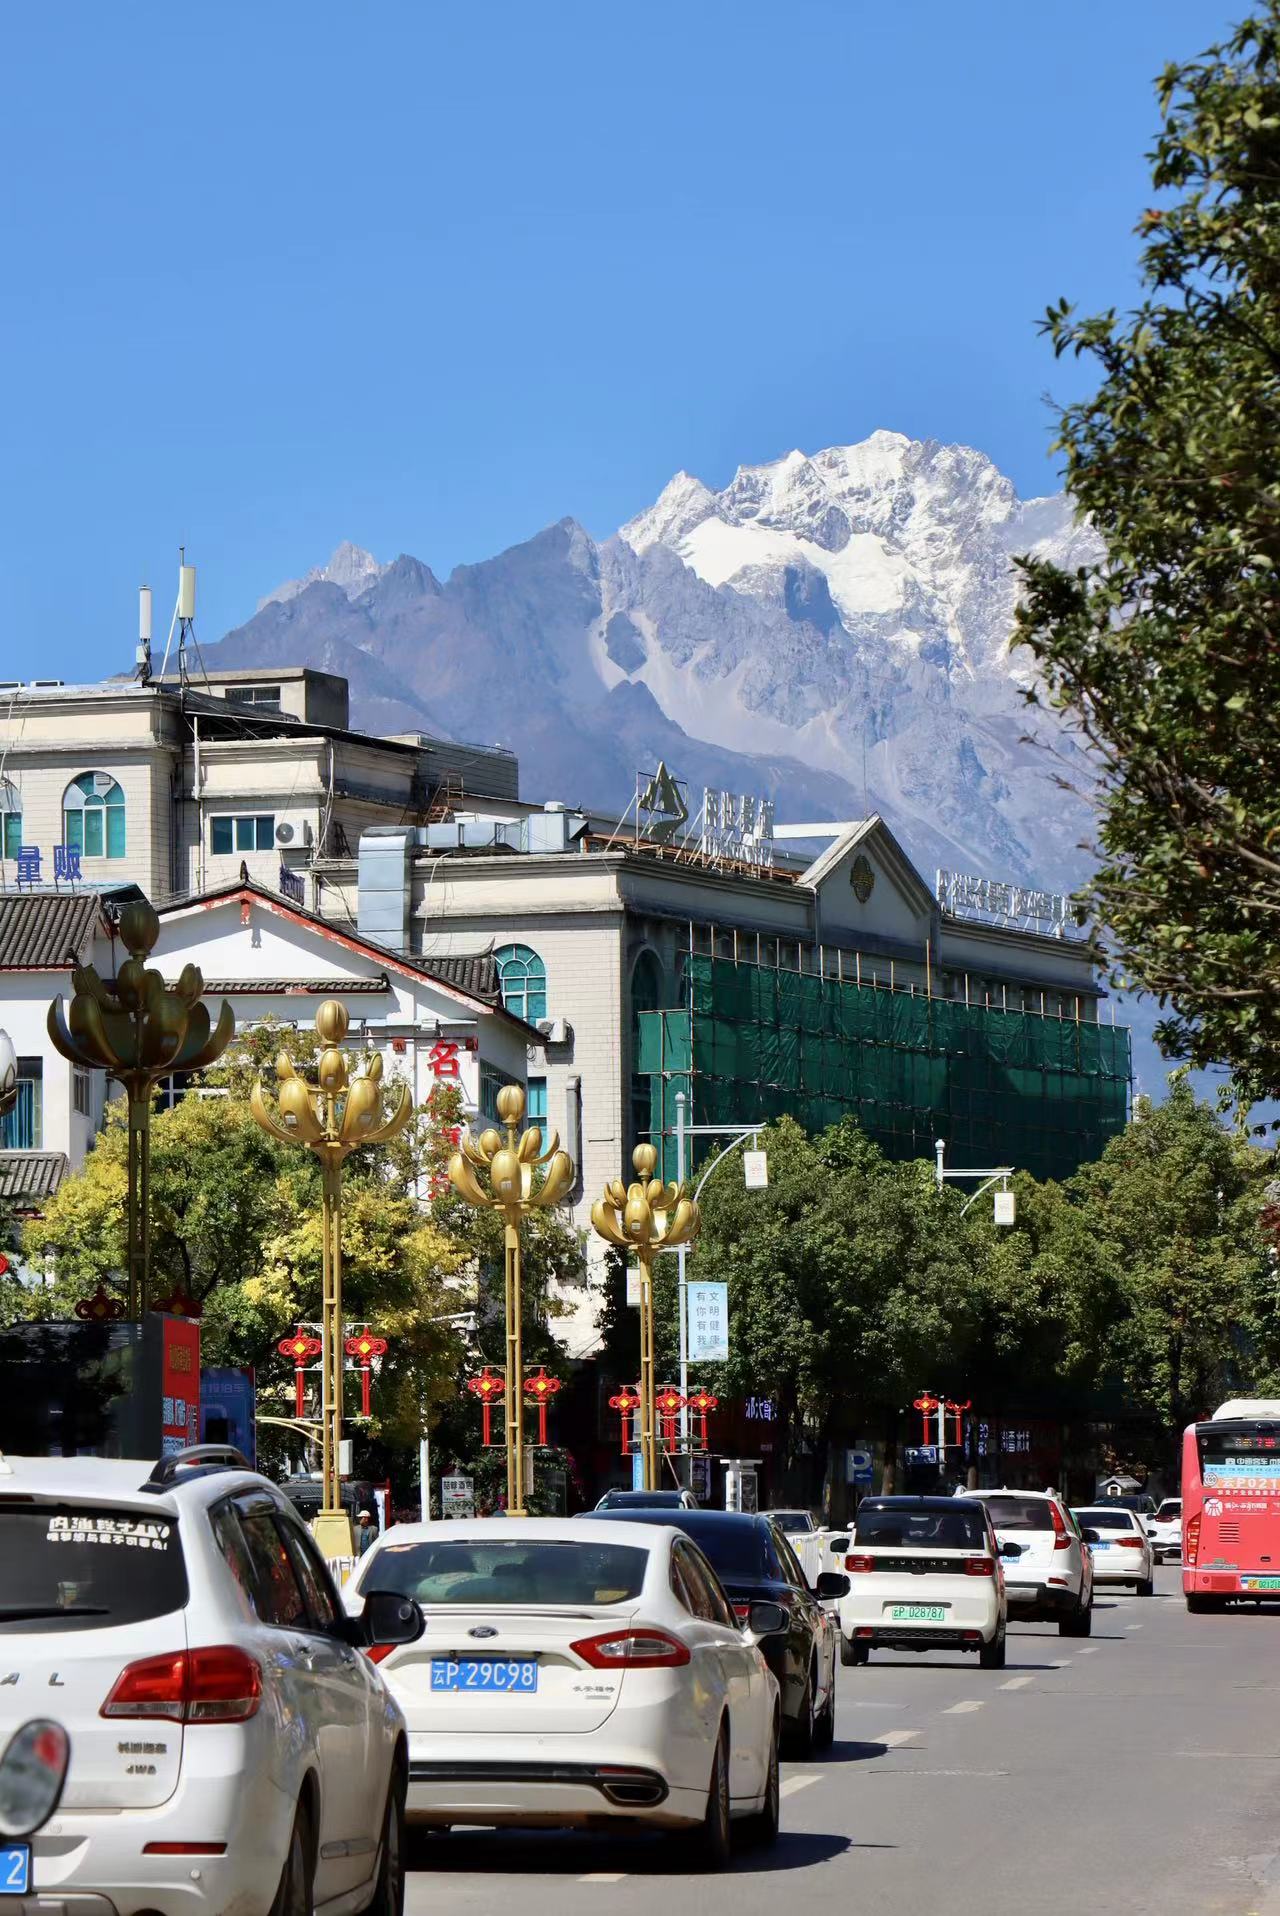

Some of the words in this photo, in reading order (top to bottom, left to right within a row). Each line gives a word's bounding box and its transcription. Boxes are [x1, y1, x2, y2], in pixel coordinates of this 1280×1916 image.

[696, 1292, 706, 1346] 有你有我
[709, 1292, 720, 1345] 文明健康
[848, 1450, 871, 1482] P
[472, 1628, 492, 1639] Ford
